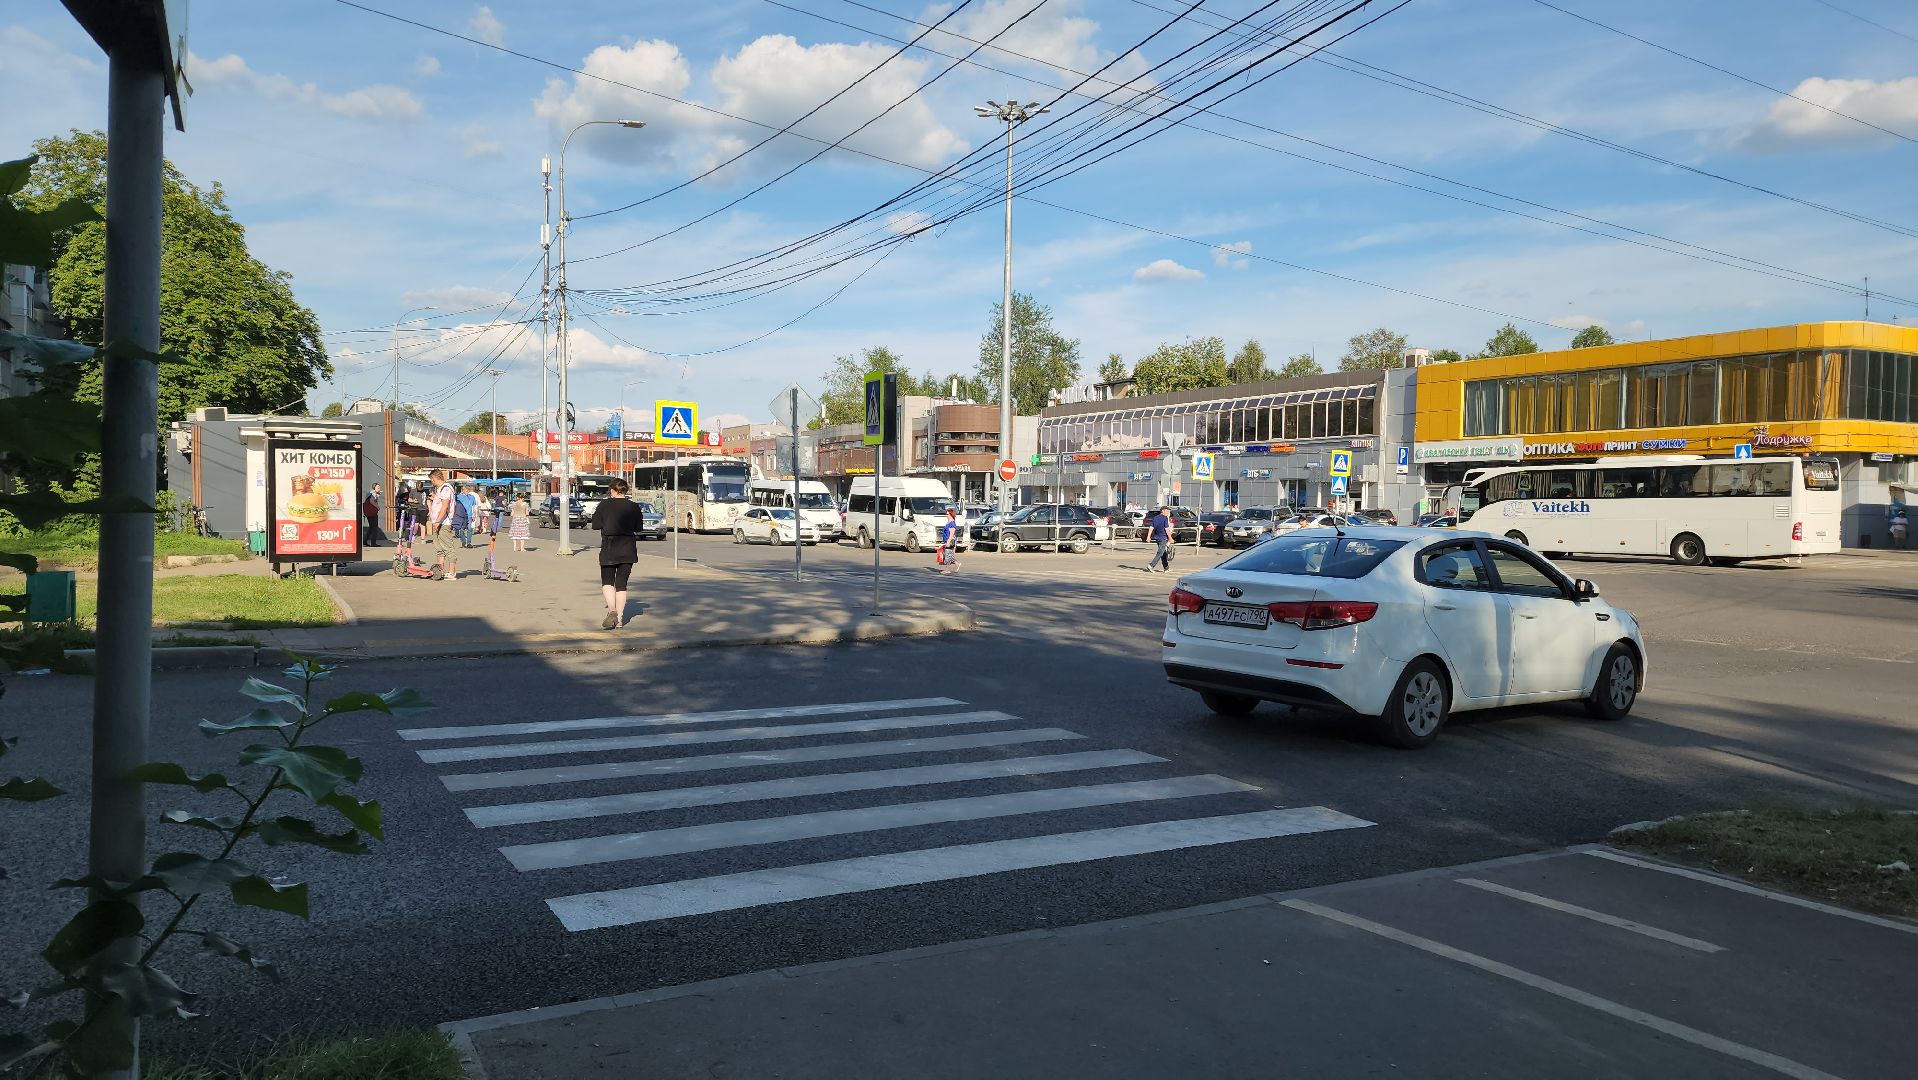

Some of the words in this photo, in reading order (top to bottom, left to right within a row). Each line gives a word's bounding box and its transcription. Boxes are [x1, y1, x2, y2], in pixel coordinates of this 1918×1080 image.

[1641, 439, 1687, 450] СУМКИ
[1754, 433, 1812, 447] Подружка
[1523, 442, 1576, 456] ОПТИКА
[281, 452, 305, 464] ХИТ
[309, 453, 352, 464] КОМБО
[1532, 501, 1591, 513] Vaitekh
[1226, 587, 1240, 596] KIA
